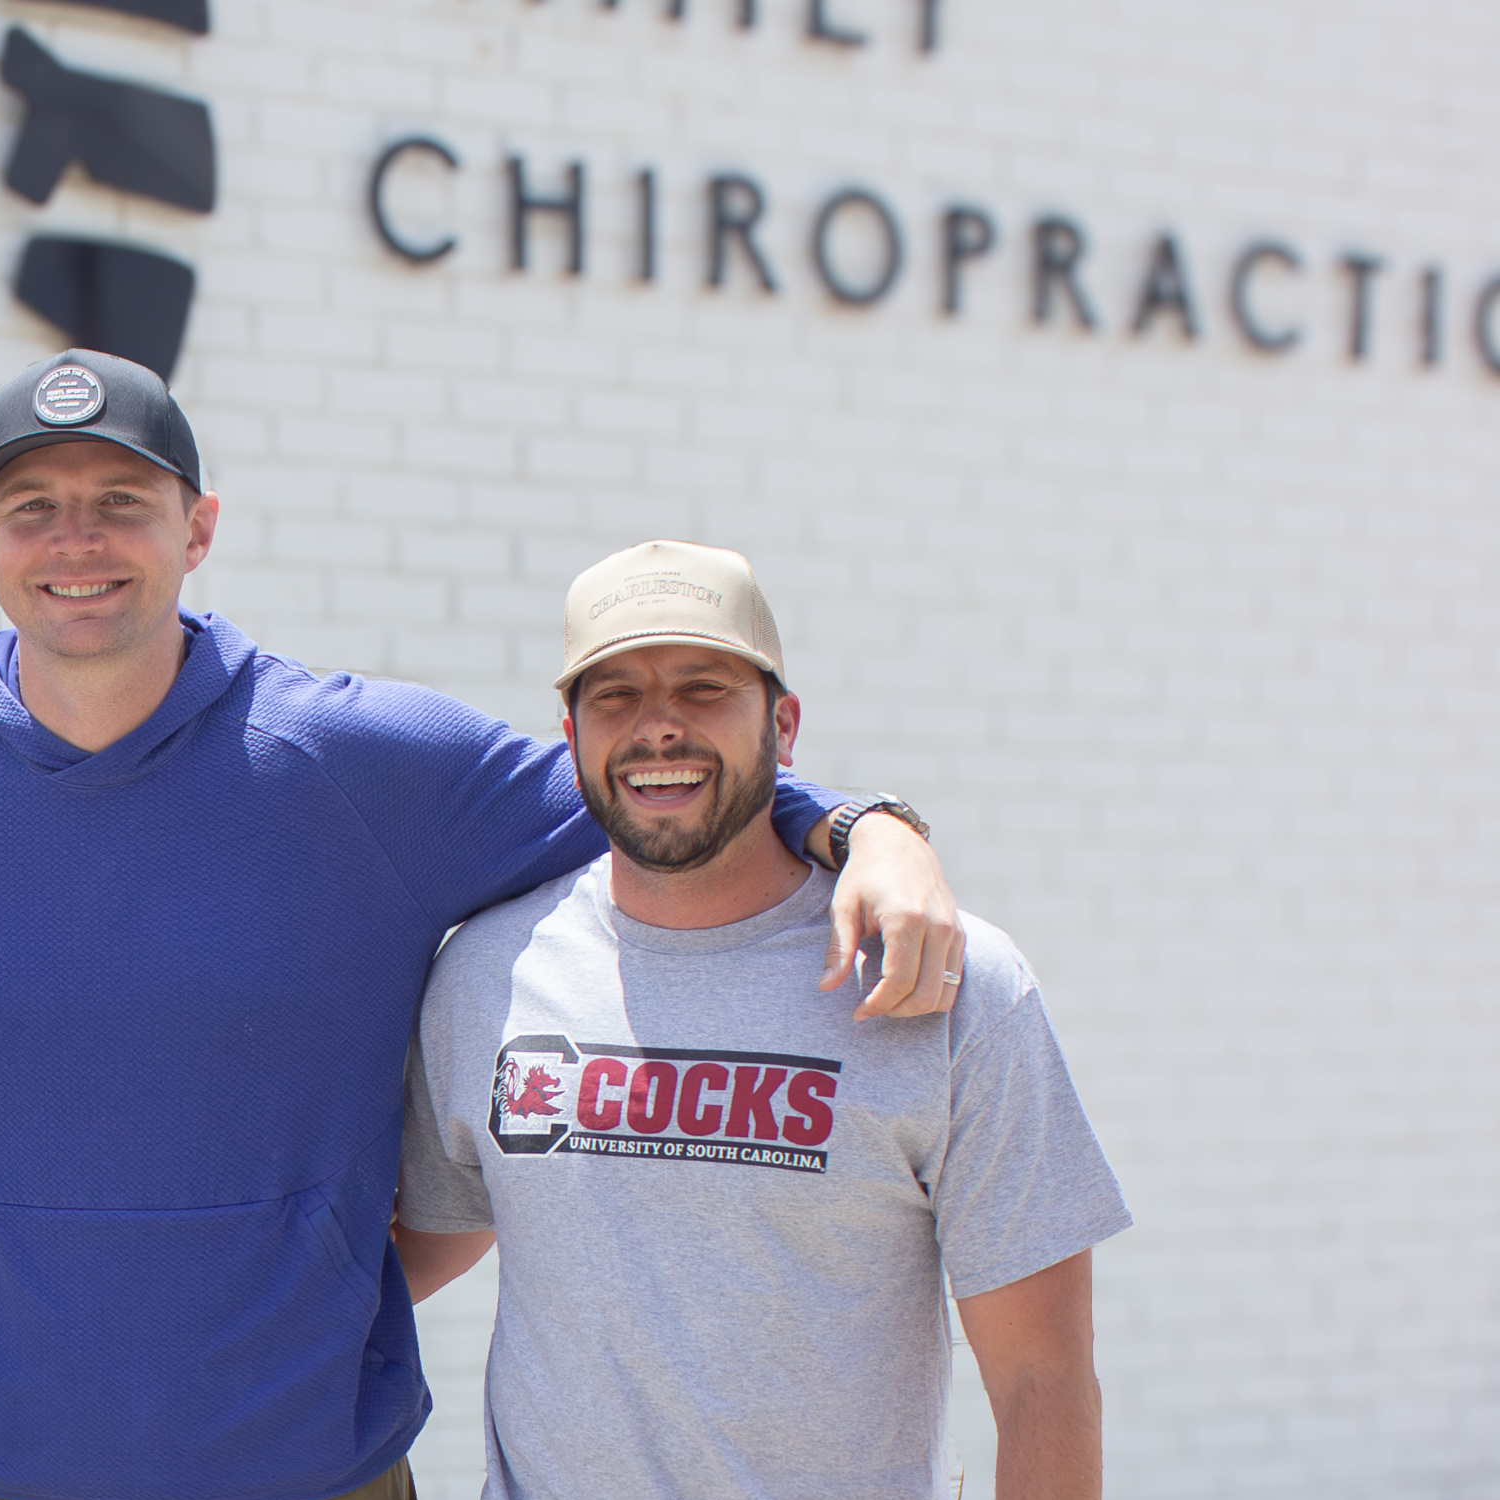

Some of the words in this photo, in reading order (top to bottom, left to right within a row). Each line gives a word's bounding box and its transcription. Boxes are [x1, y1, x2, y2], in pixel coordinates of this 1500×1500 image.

[588, 579, 723, 620] CHARLESTON
[576, 1057, 838, 1147] COCKS
[568, 1136, 662, 1157] UNIVERSITY
[663, 1142, 685, 1157] OF
[686, 1144, 739, 1162] SOUTH
[740, 1148, 823, 1170] CAROLINA
